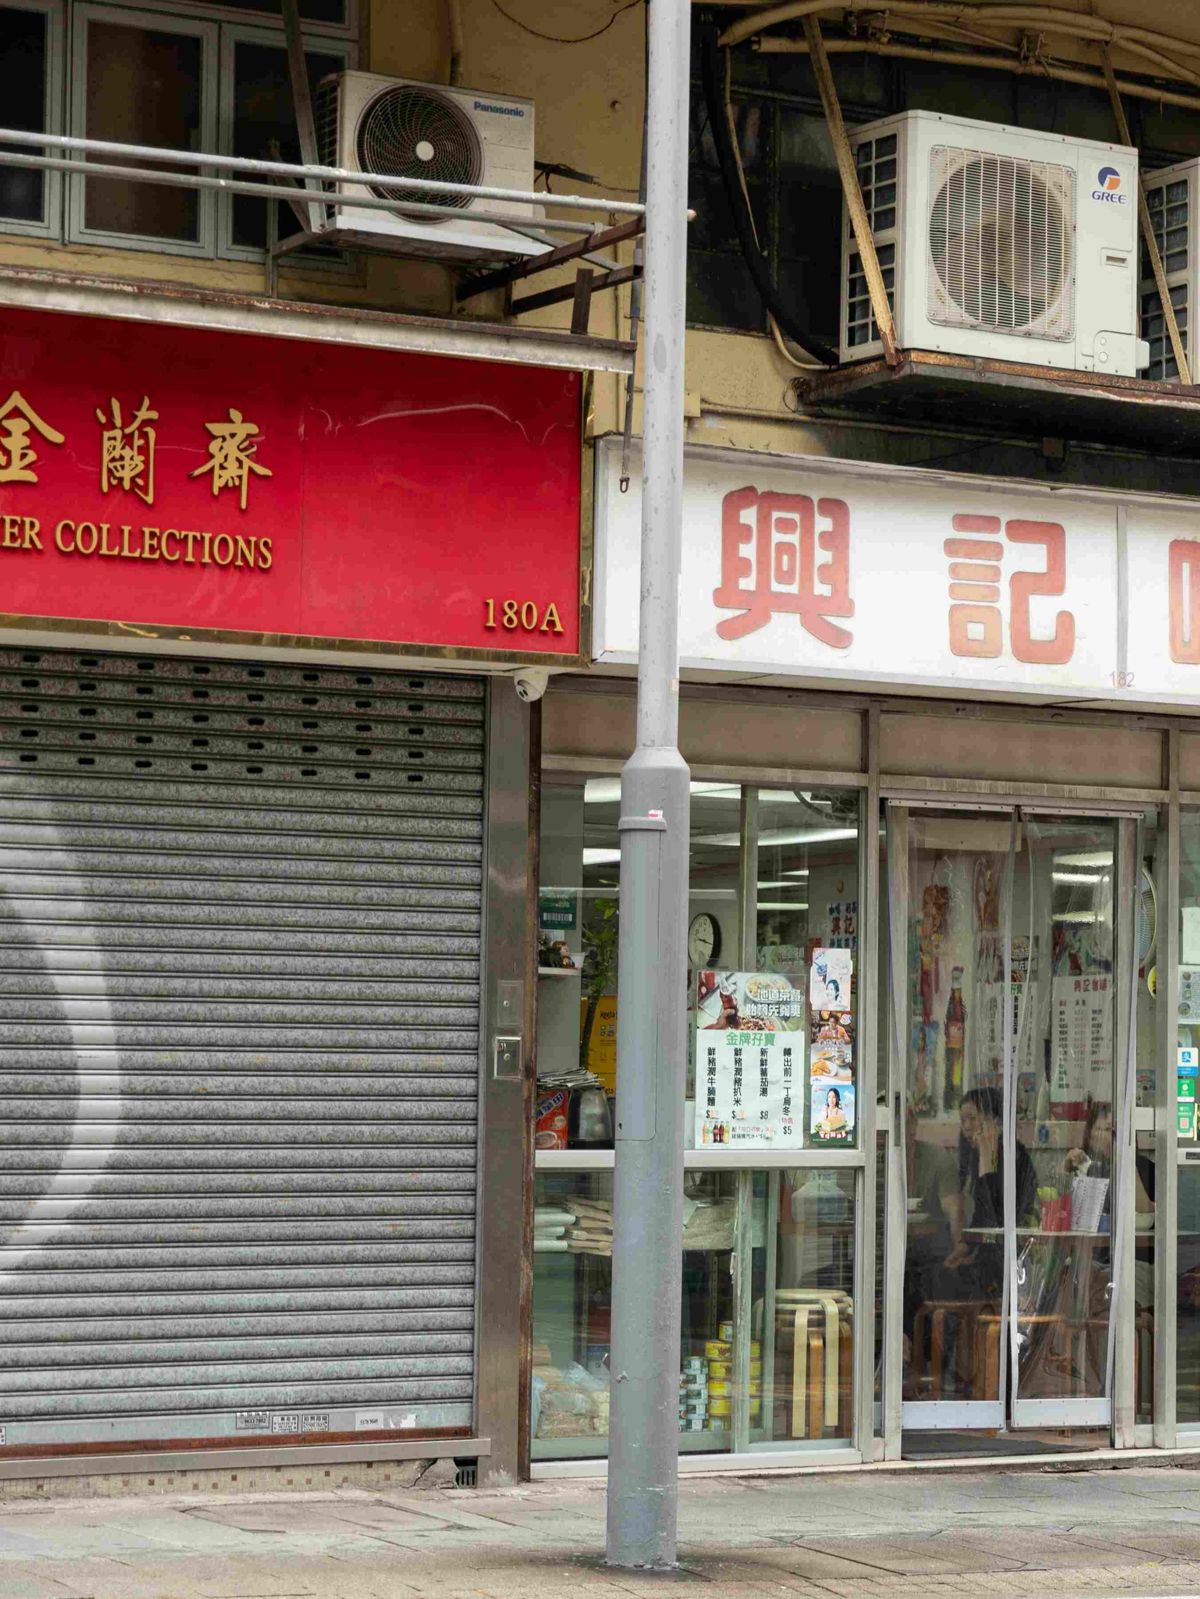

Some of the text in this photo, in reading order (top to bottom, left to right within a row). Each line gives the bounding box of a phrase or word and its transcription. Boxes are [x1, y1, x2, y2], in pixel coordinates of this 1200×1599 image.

[474, 101, 525, 117] Panasonic
[1092, 190, 1127, 205] GREE
[56, 519, 272, 569] COLLECTIONS
[484, 598, 564, 633] 180A
[1109, 671, 1135, 688] 182
